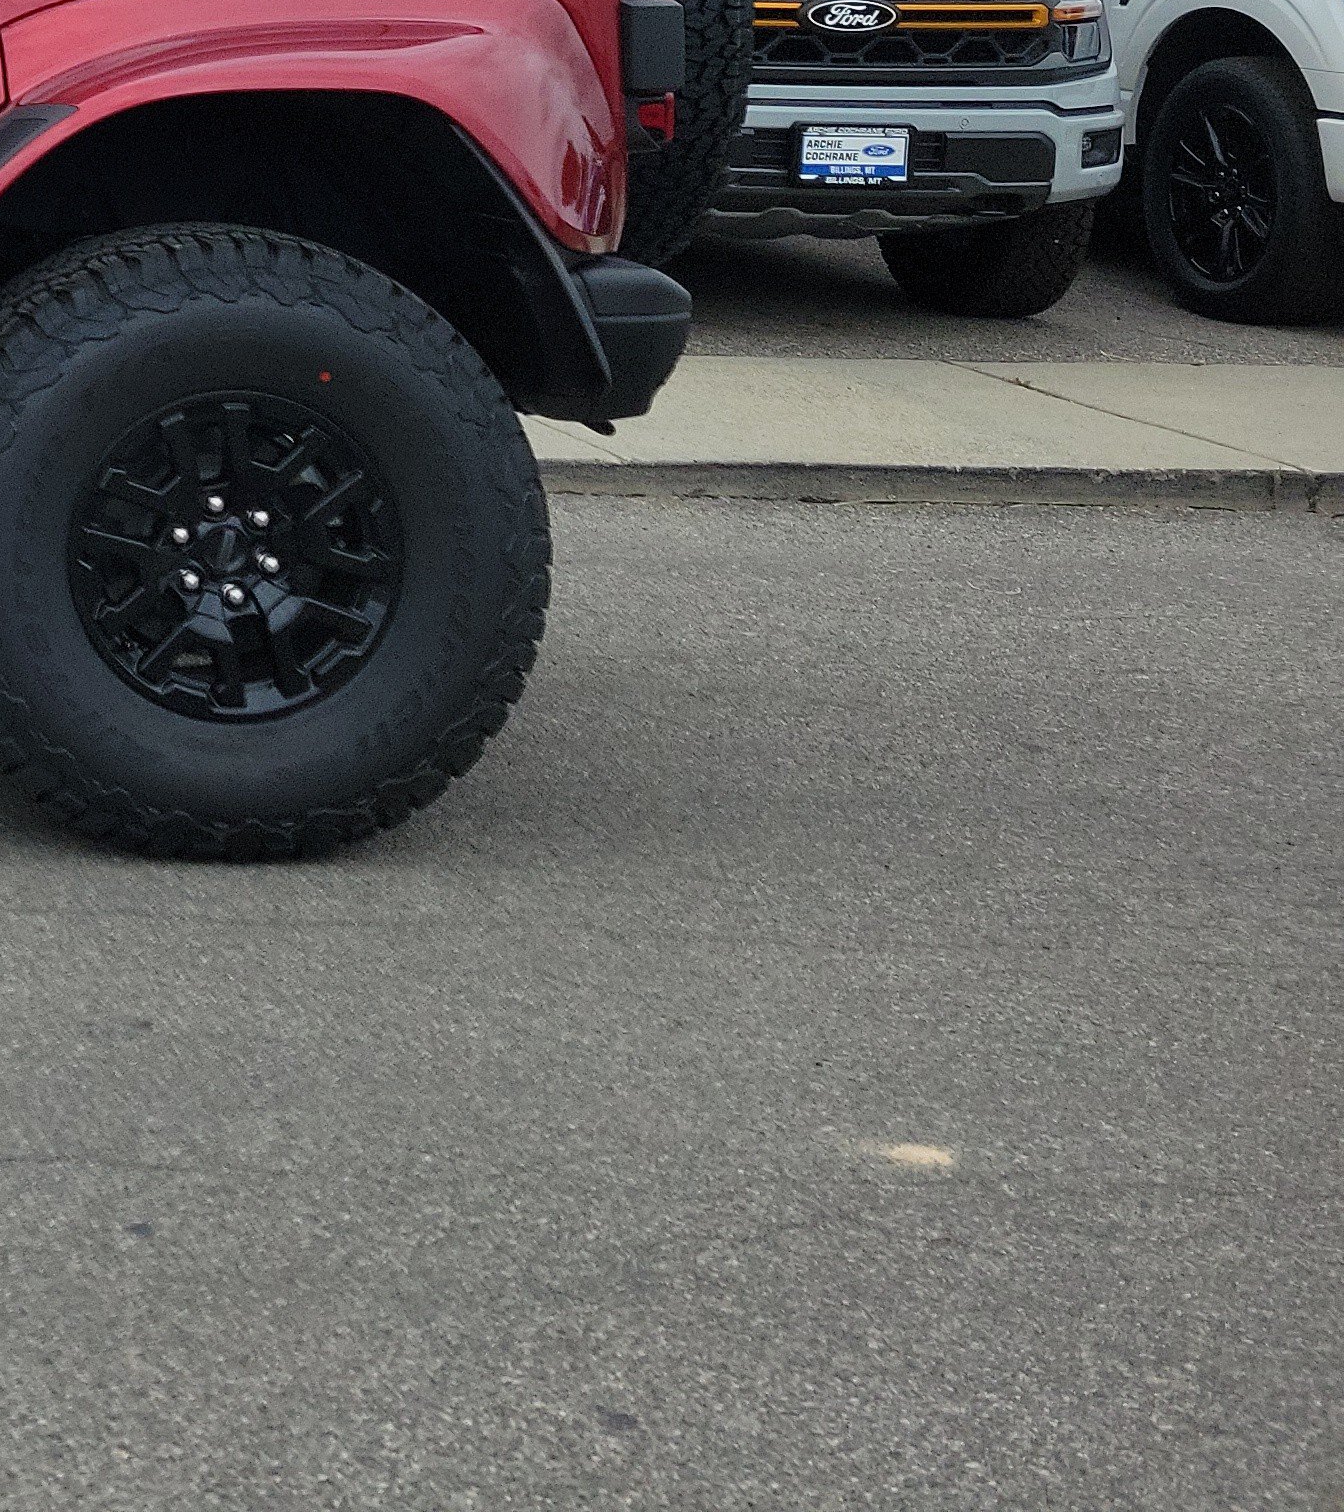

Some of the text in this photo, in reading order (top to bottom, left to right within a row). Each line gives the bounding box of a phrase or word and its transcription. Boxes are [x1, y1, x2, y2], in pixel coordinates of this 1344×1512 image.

[824, 4, 880, 26] Ford
[807, 140, 843, 149] ARCHIE
[805, 151, 859, 162] COCHRANE
